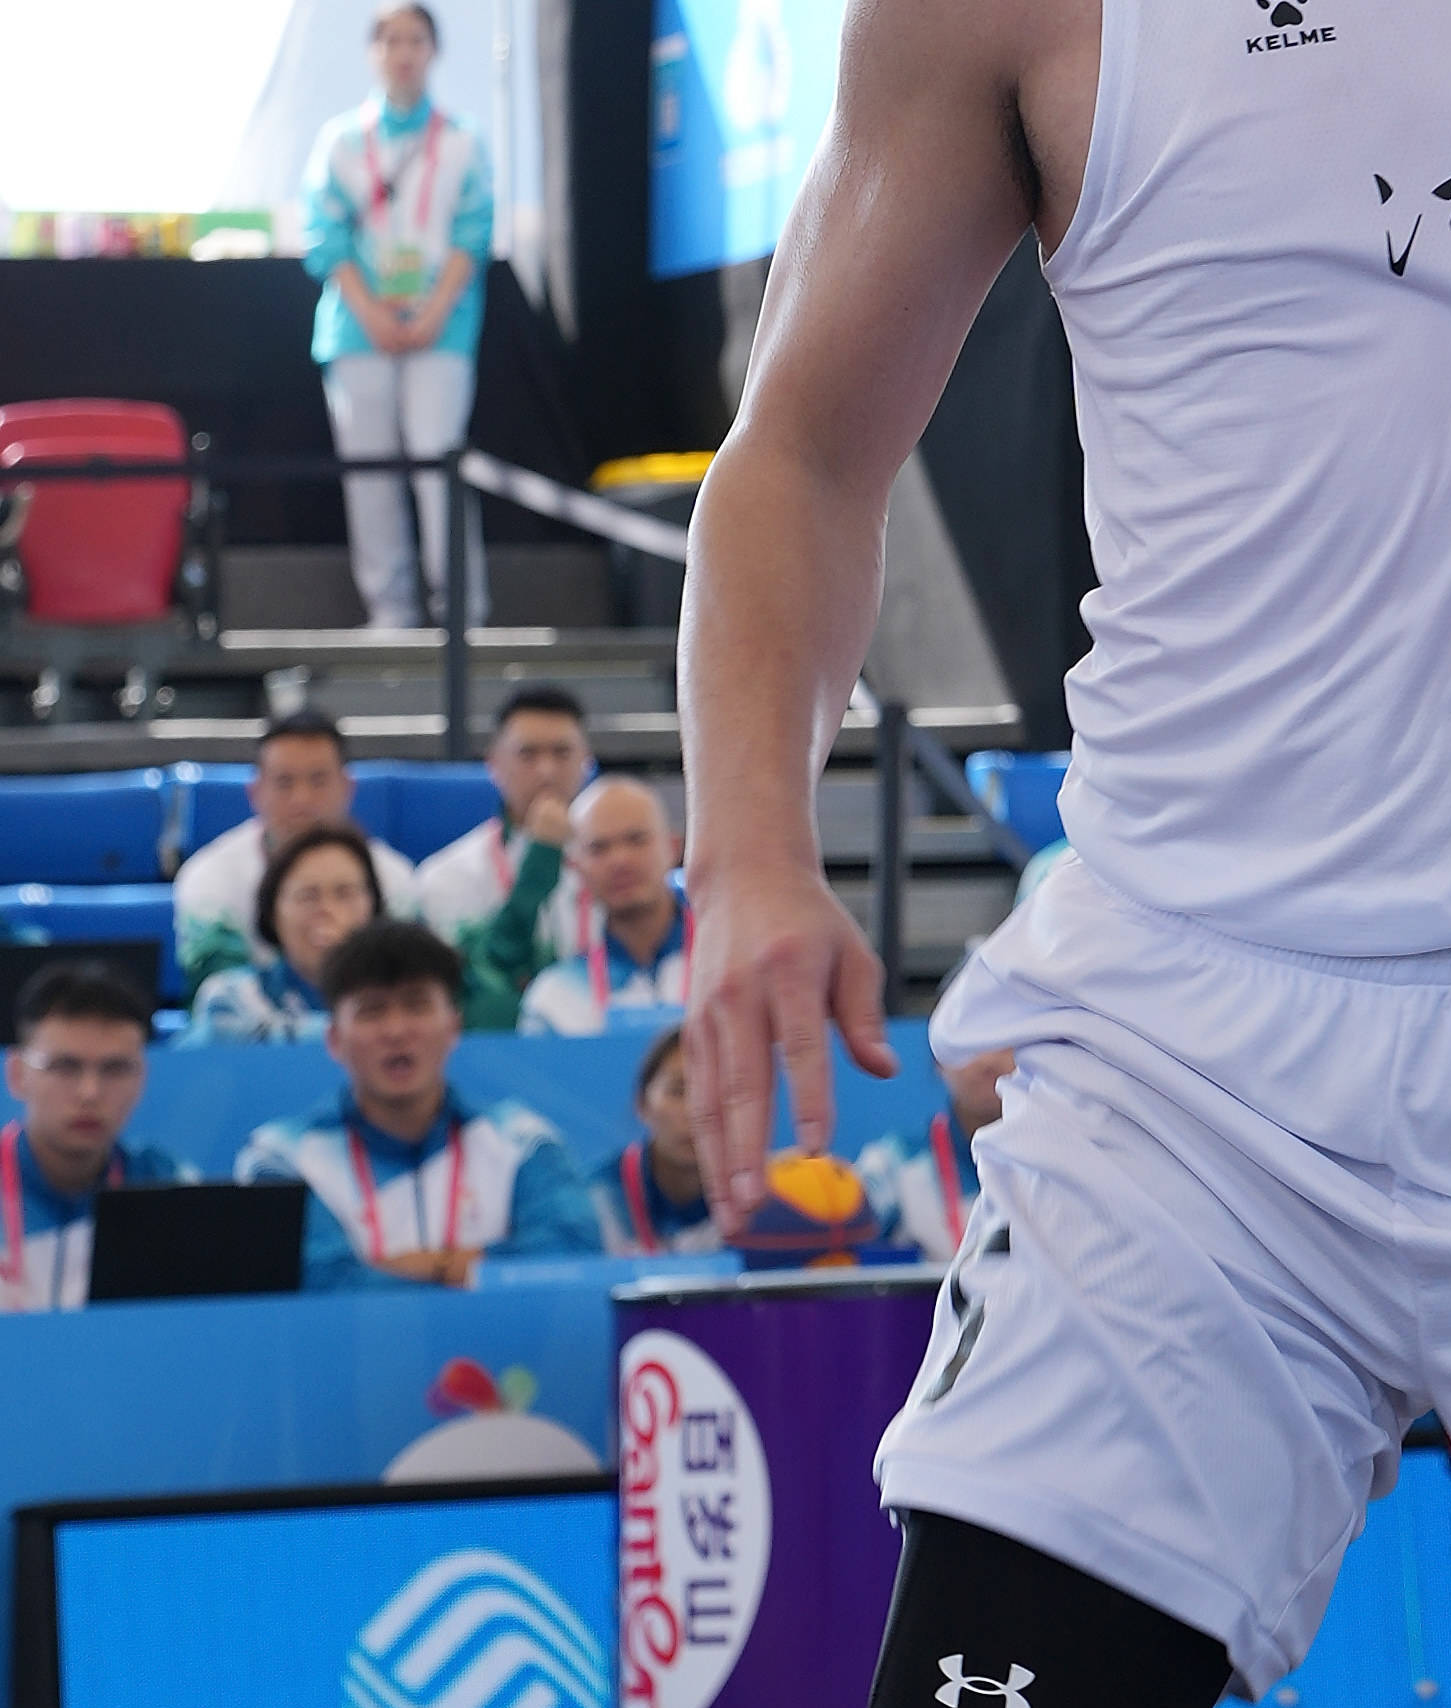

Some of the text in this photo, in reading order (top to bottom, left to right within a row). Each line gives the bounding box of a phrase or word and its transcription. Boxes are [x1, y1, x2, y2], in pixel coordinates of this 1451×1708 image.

[1246, 26, 1337, 54] KELME
[681, 1412, 736, 1646] 百岁山
